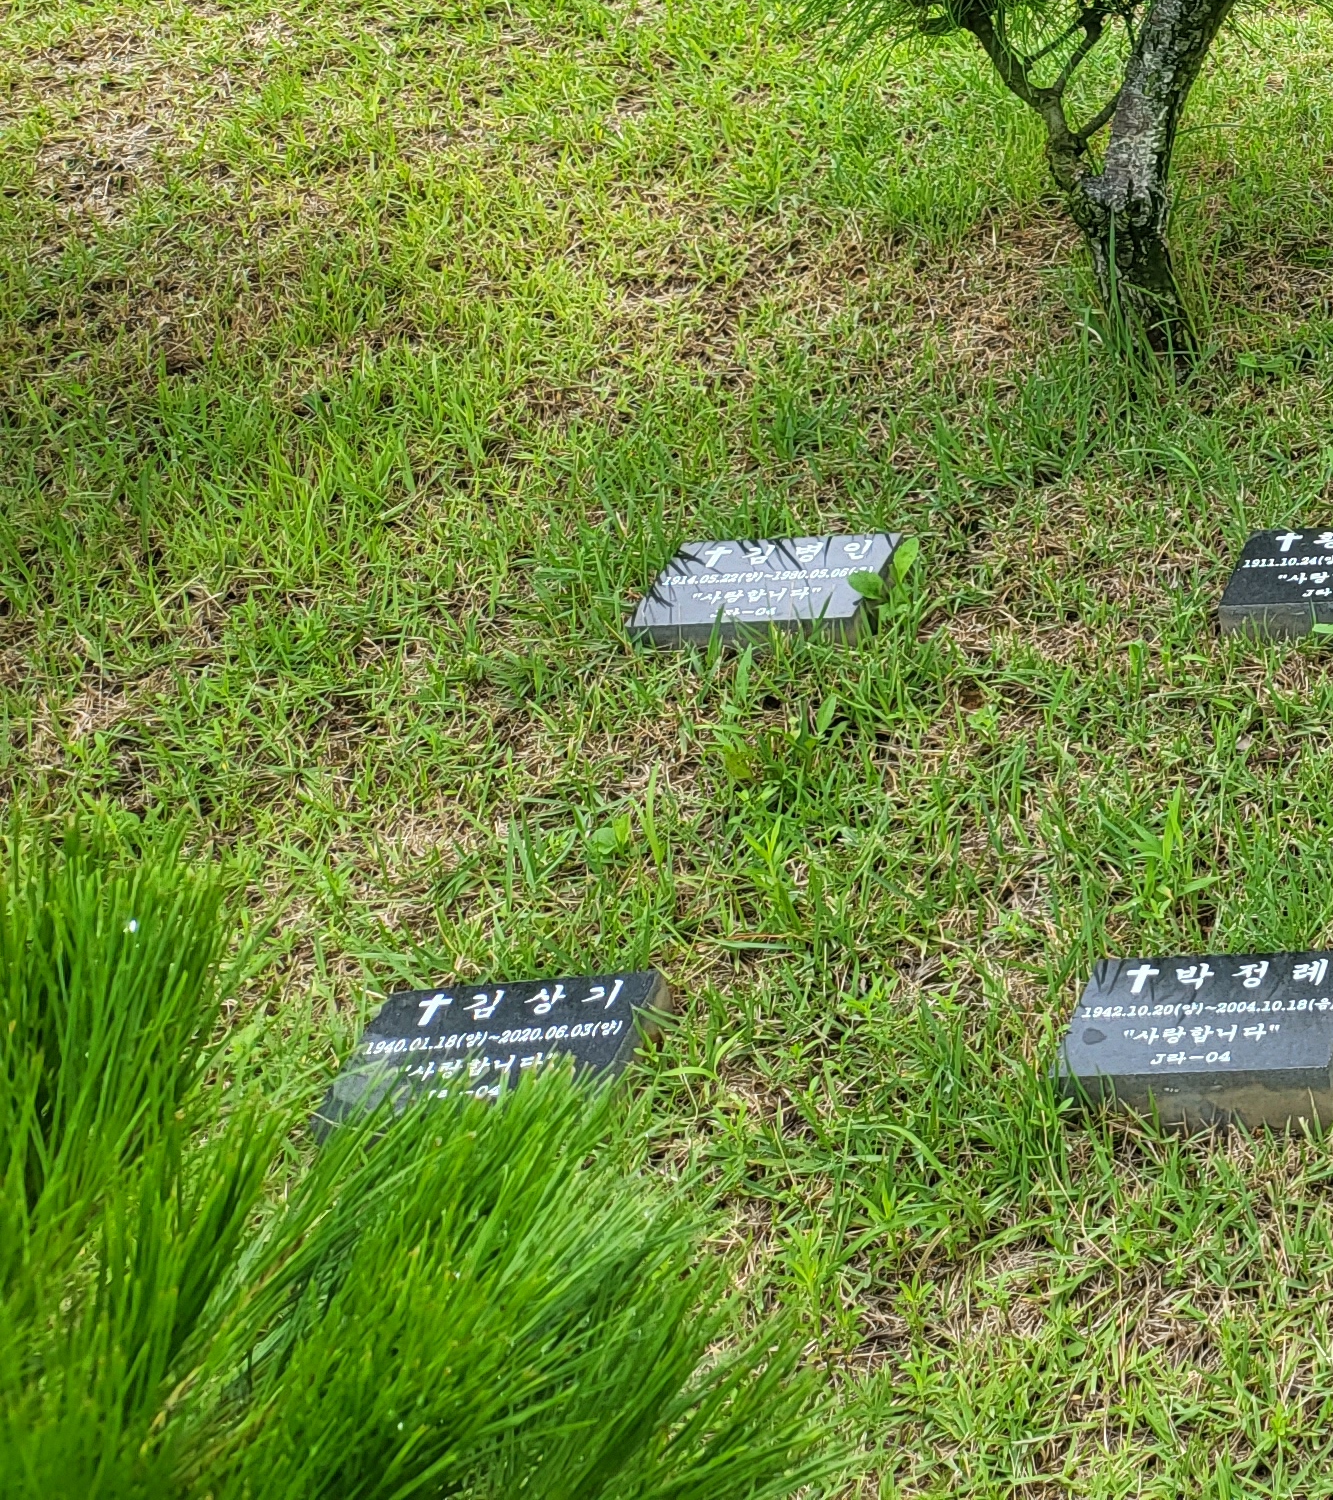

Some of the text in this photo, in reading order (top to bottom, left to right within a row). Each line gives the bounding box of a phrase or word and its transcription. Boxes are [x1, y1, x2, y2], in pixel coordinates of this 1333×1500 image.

[662, 566, 874, 586] 1914.05.22(양)~1980.05.06()
[1123, 1023, 1280, 1045] "사랑합니다"
[1150, 1050, 1231, 1066] J라-04
